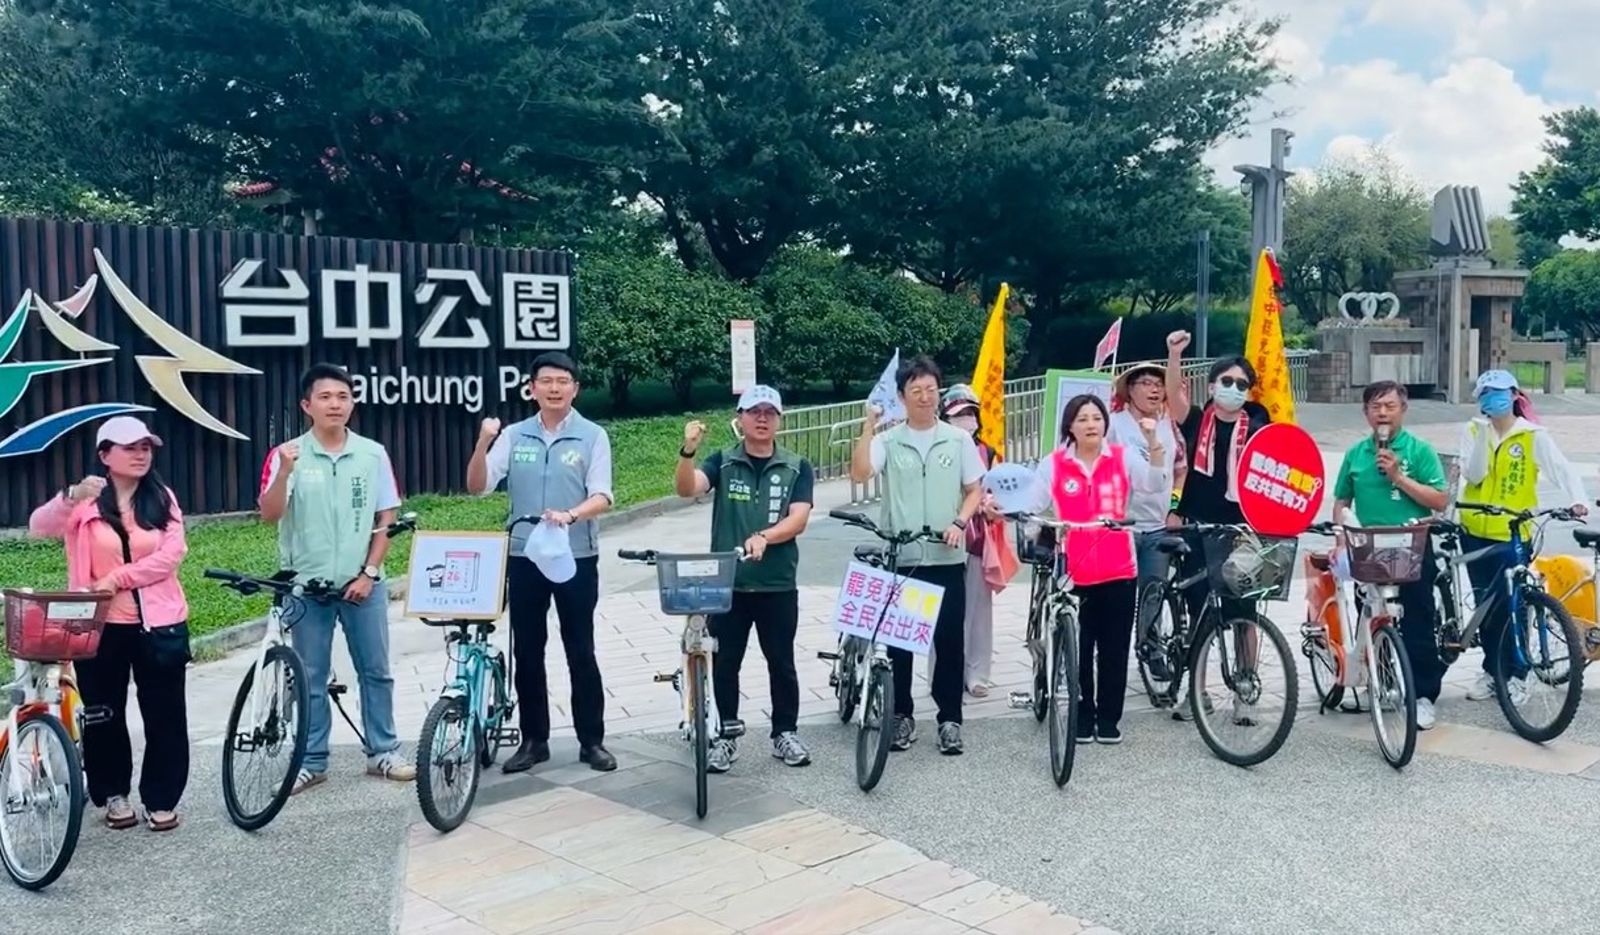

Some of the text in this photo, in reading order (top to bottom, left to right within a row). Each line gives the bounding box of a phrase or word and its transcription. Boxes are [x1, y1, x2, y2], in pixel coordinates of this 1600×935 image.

[219, 257, 571, 349] 台中公園
[343, 365, 483, 413] aichung
[838, 600, 932, 646] 全民站出來
